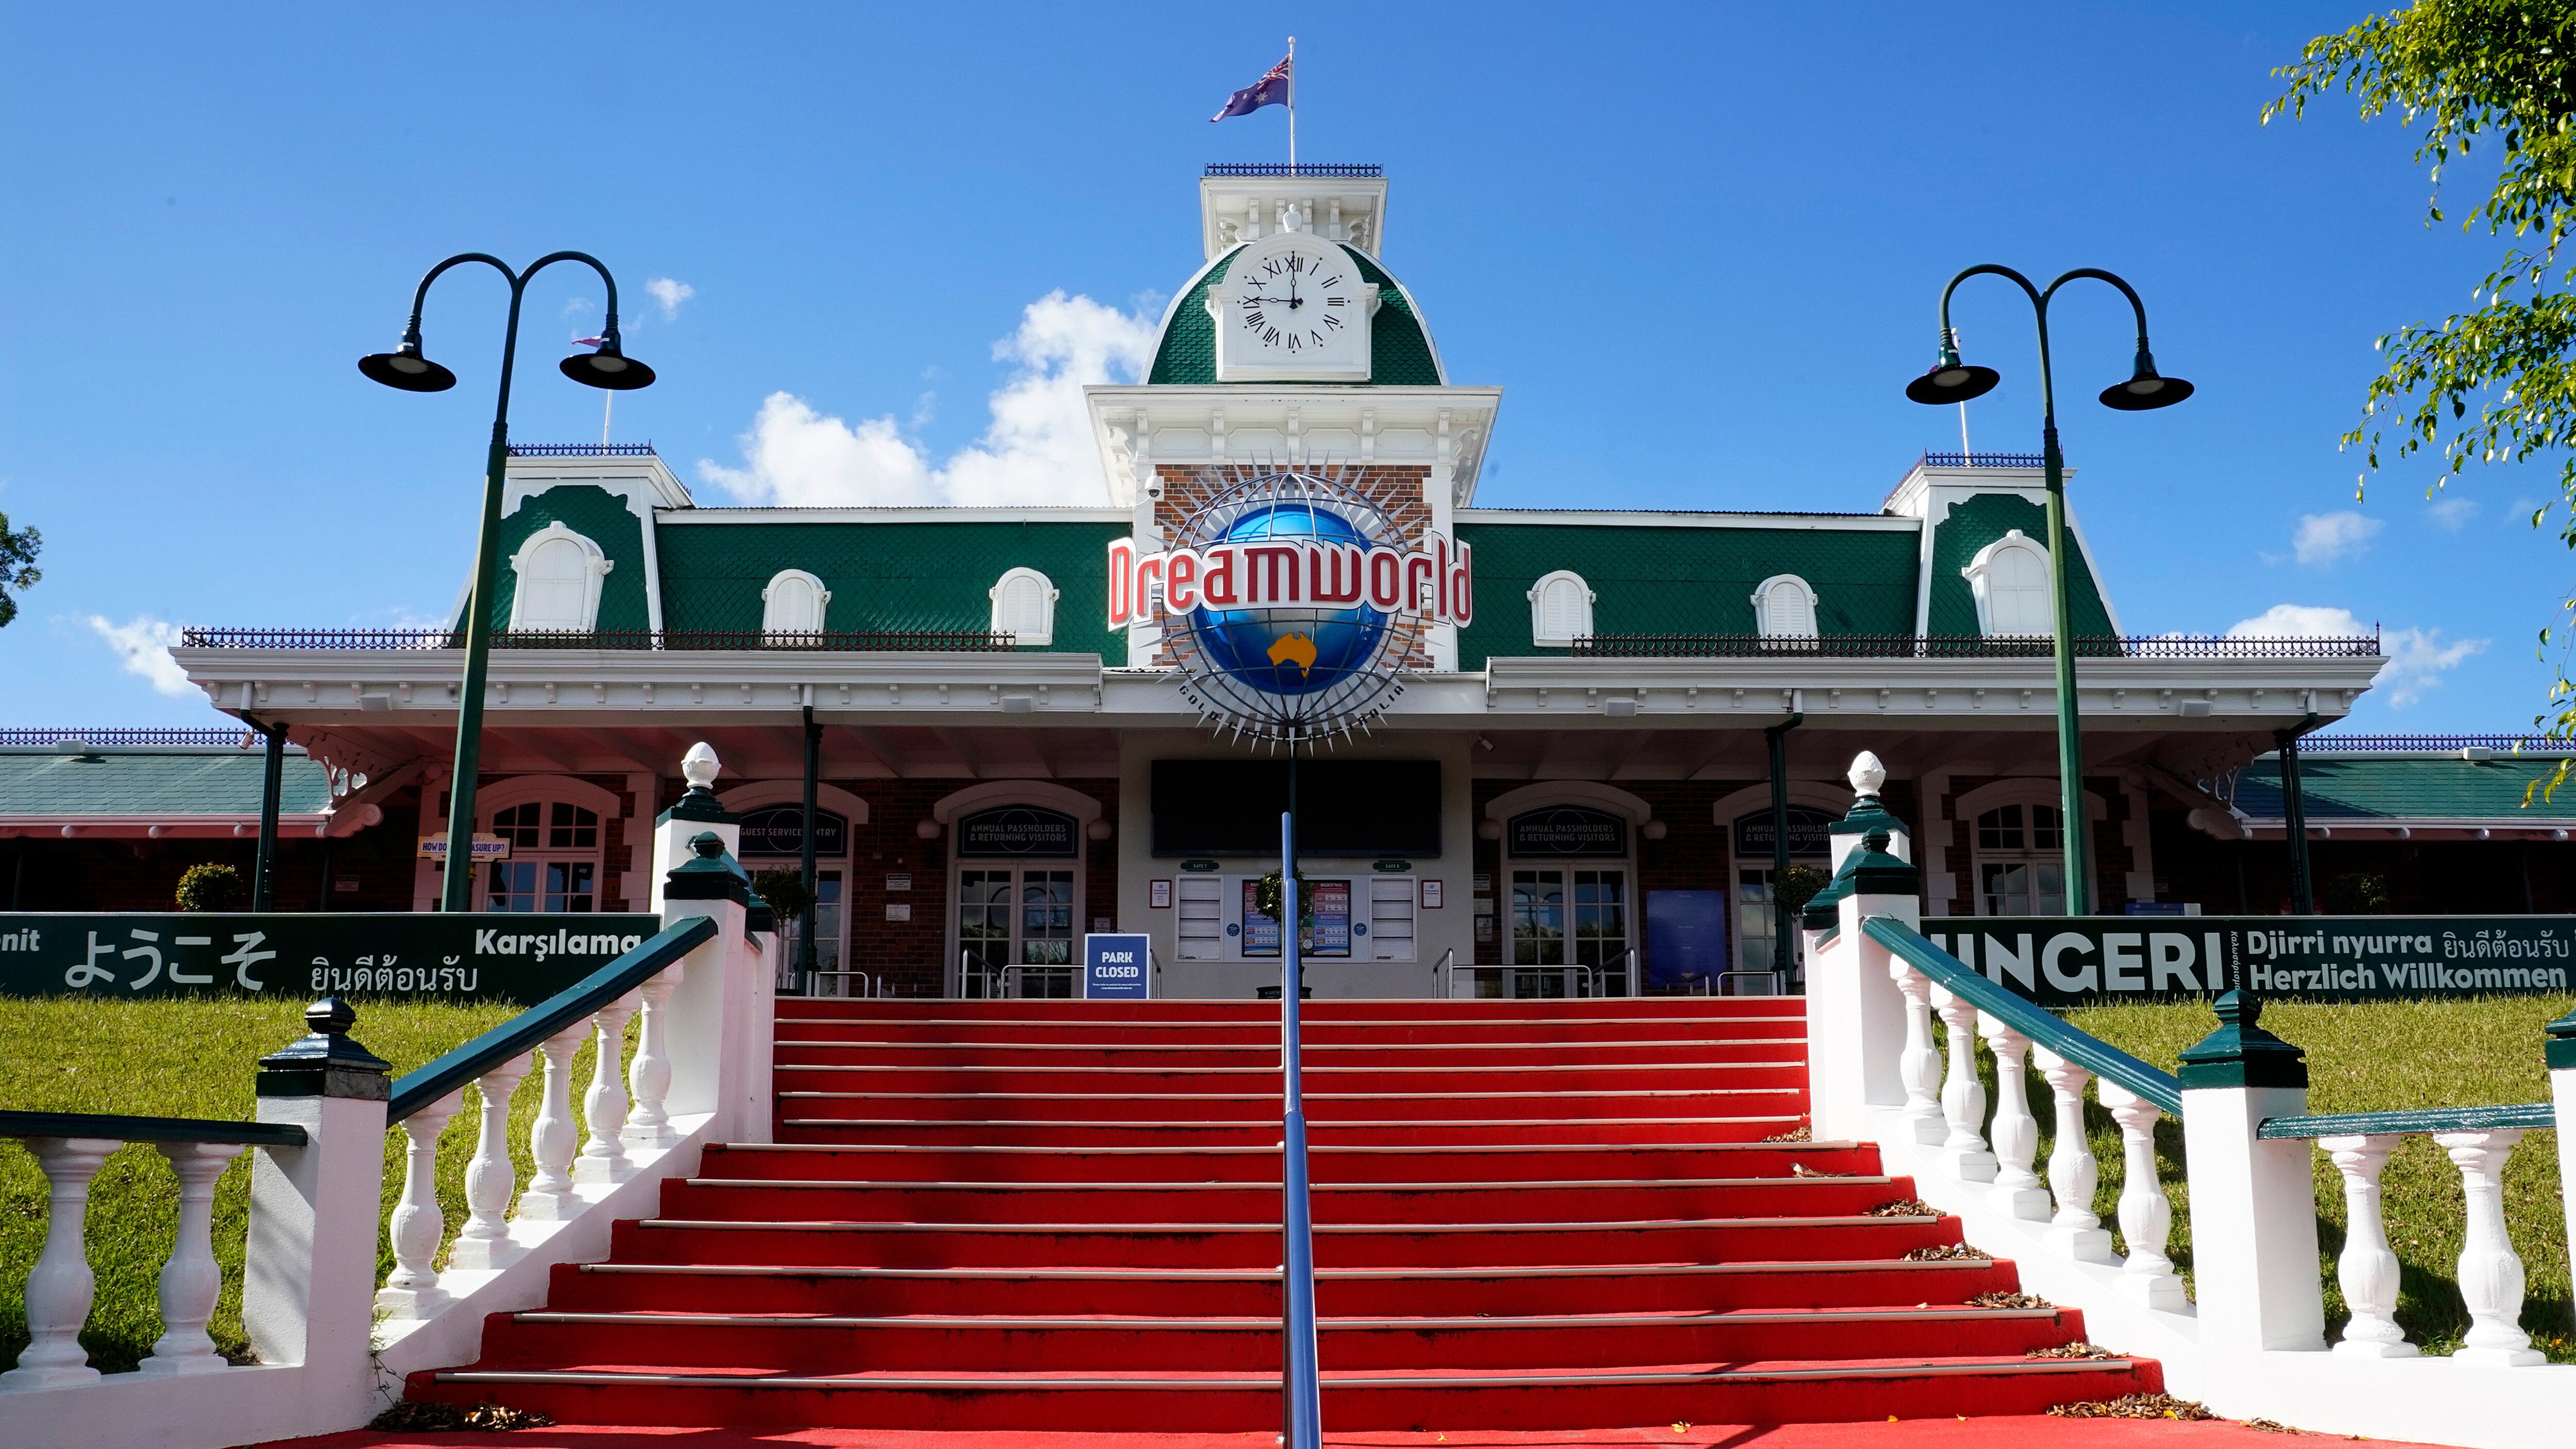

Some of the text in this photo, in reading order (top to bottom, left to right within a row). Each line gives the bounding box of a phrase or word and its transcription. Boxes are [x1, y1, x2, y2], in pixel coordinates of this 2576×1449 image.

[1262, 260, 1281, 279] XI
[1284, 257, 1303, 272] XII
[1309, 263, 1319, 276] I
[1248, 276, 1266, 291] X
[1321, 277, 1338, 289] II
[1243, 296, 1260, 309] IX
[1327, 297, 1345, 306] III
[1246, 311, 1266, 333] VIII
[1323, 314, 1340, 331] IV
[1262, 326, 1280, 346] VII
[1288, 333, 1301, 349] VI
[1311, 329, 1323, 344] V
[1110, 538, 1471, 623] Dreamworld
[1179, 685, 1218, 721] GOLD
[740, 828, 837, 836] GUEST SERVICE NTRY
[1520, 824, 1614, 833] ANNUAL PASSHOLDERS
[970, 833, 976, 841] &
[1519, 833, 1615, 841] & RETURNING VISITORS
[1745, 833, 1829, 841] & RETUNG VISITO
[422, 842, 437, 851] HOW
[438, 843, 447, 851] DO
[492, 844, 505, 852] UP?
[0, 928, 40, 952] nit
[475, 929, 641, 962] Karşılama
[2247, 930, 2432, 959] Djirri nyurra
[2443, 929, 2569, 958] ยินดีต้อนรับ
[65, 929, 277, 991] ようこそ
[1101, 952, 1133, 963] PARK
[311, 954, 478, 991] ยินดีต้อนรับ
[1095, 966, 1139, 978] CLOSED
[2249, 962, 2567, 990] Herzlich Willkommen
